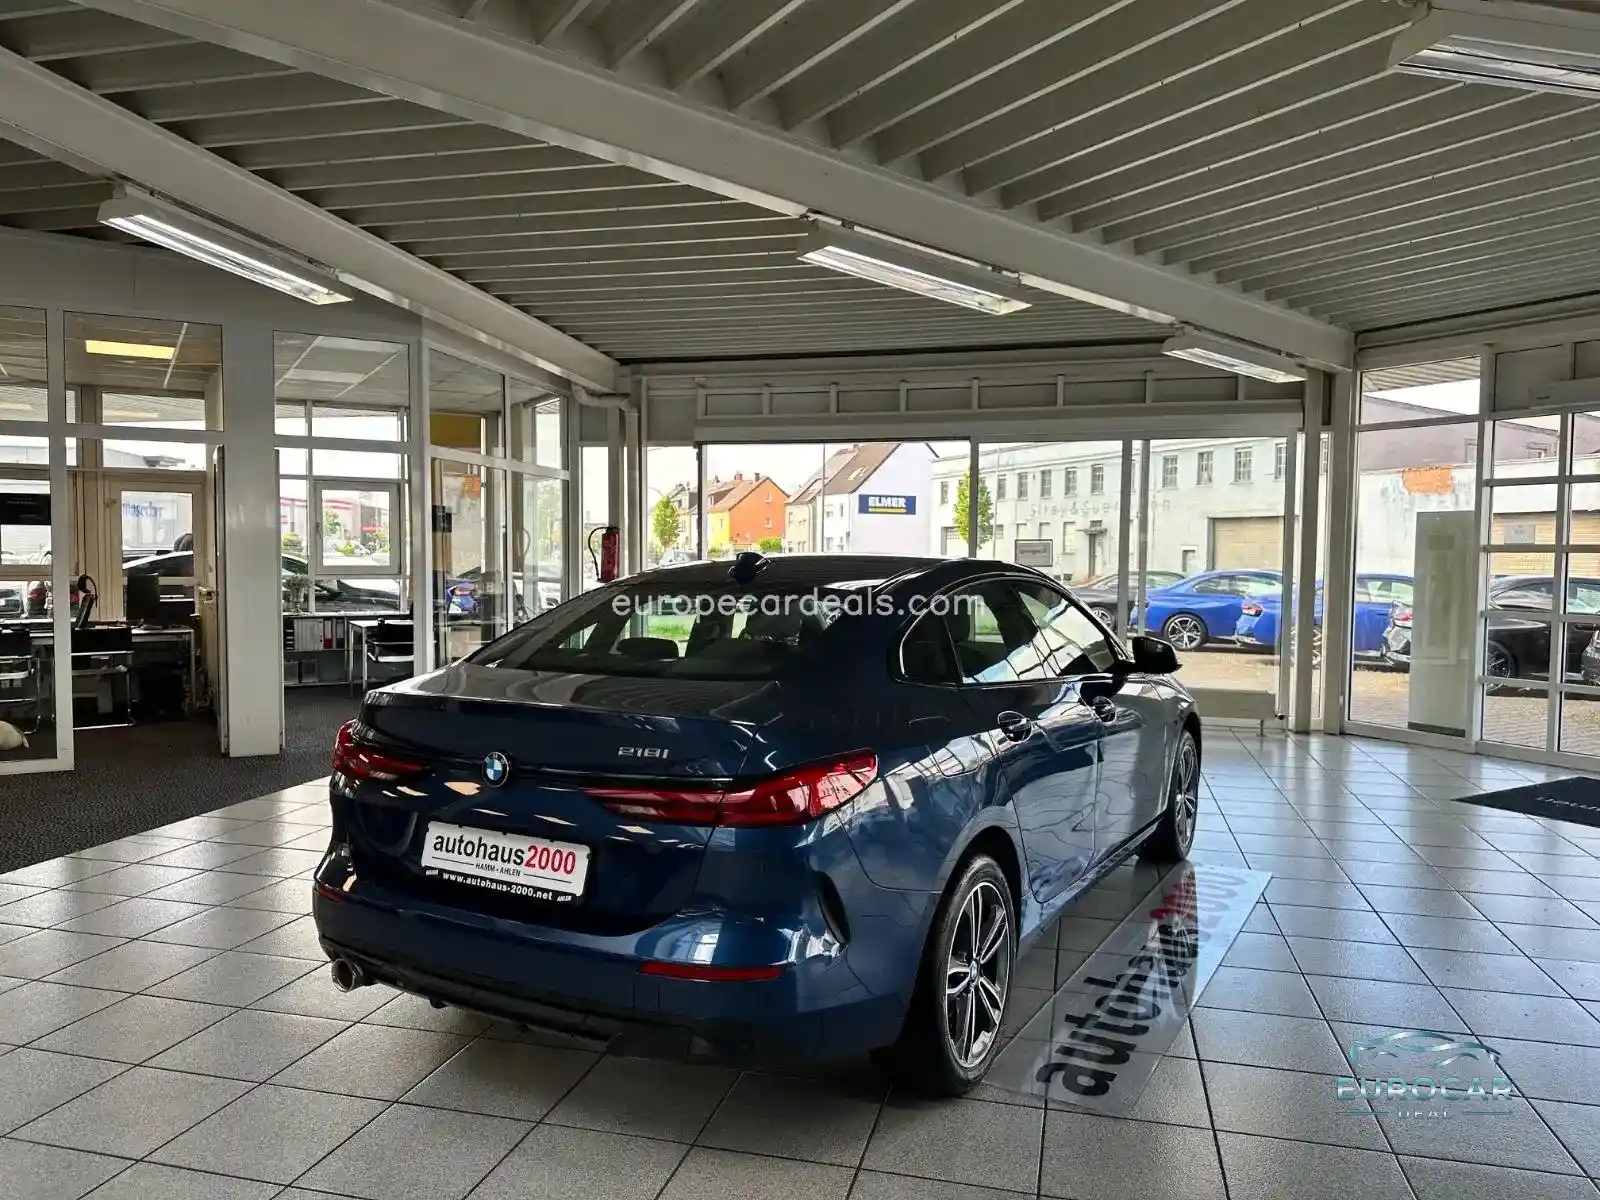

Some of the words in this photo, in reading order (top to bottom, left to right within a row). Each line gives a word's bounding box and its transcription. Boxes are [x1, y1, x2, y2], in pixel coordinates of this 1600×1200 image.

[868, 496, 907, 508] ELMER
[433, 834, 576, 875] autohaus2000
[499, 867, 521, 877] AHLEN
[442, 872, 553, 900] www.autohaus-2000.net
